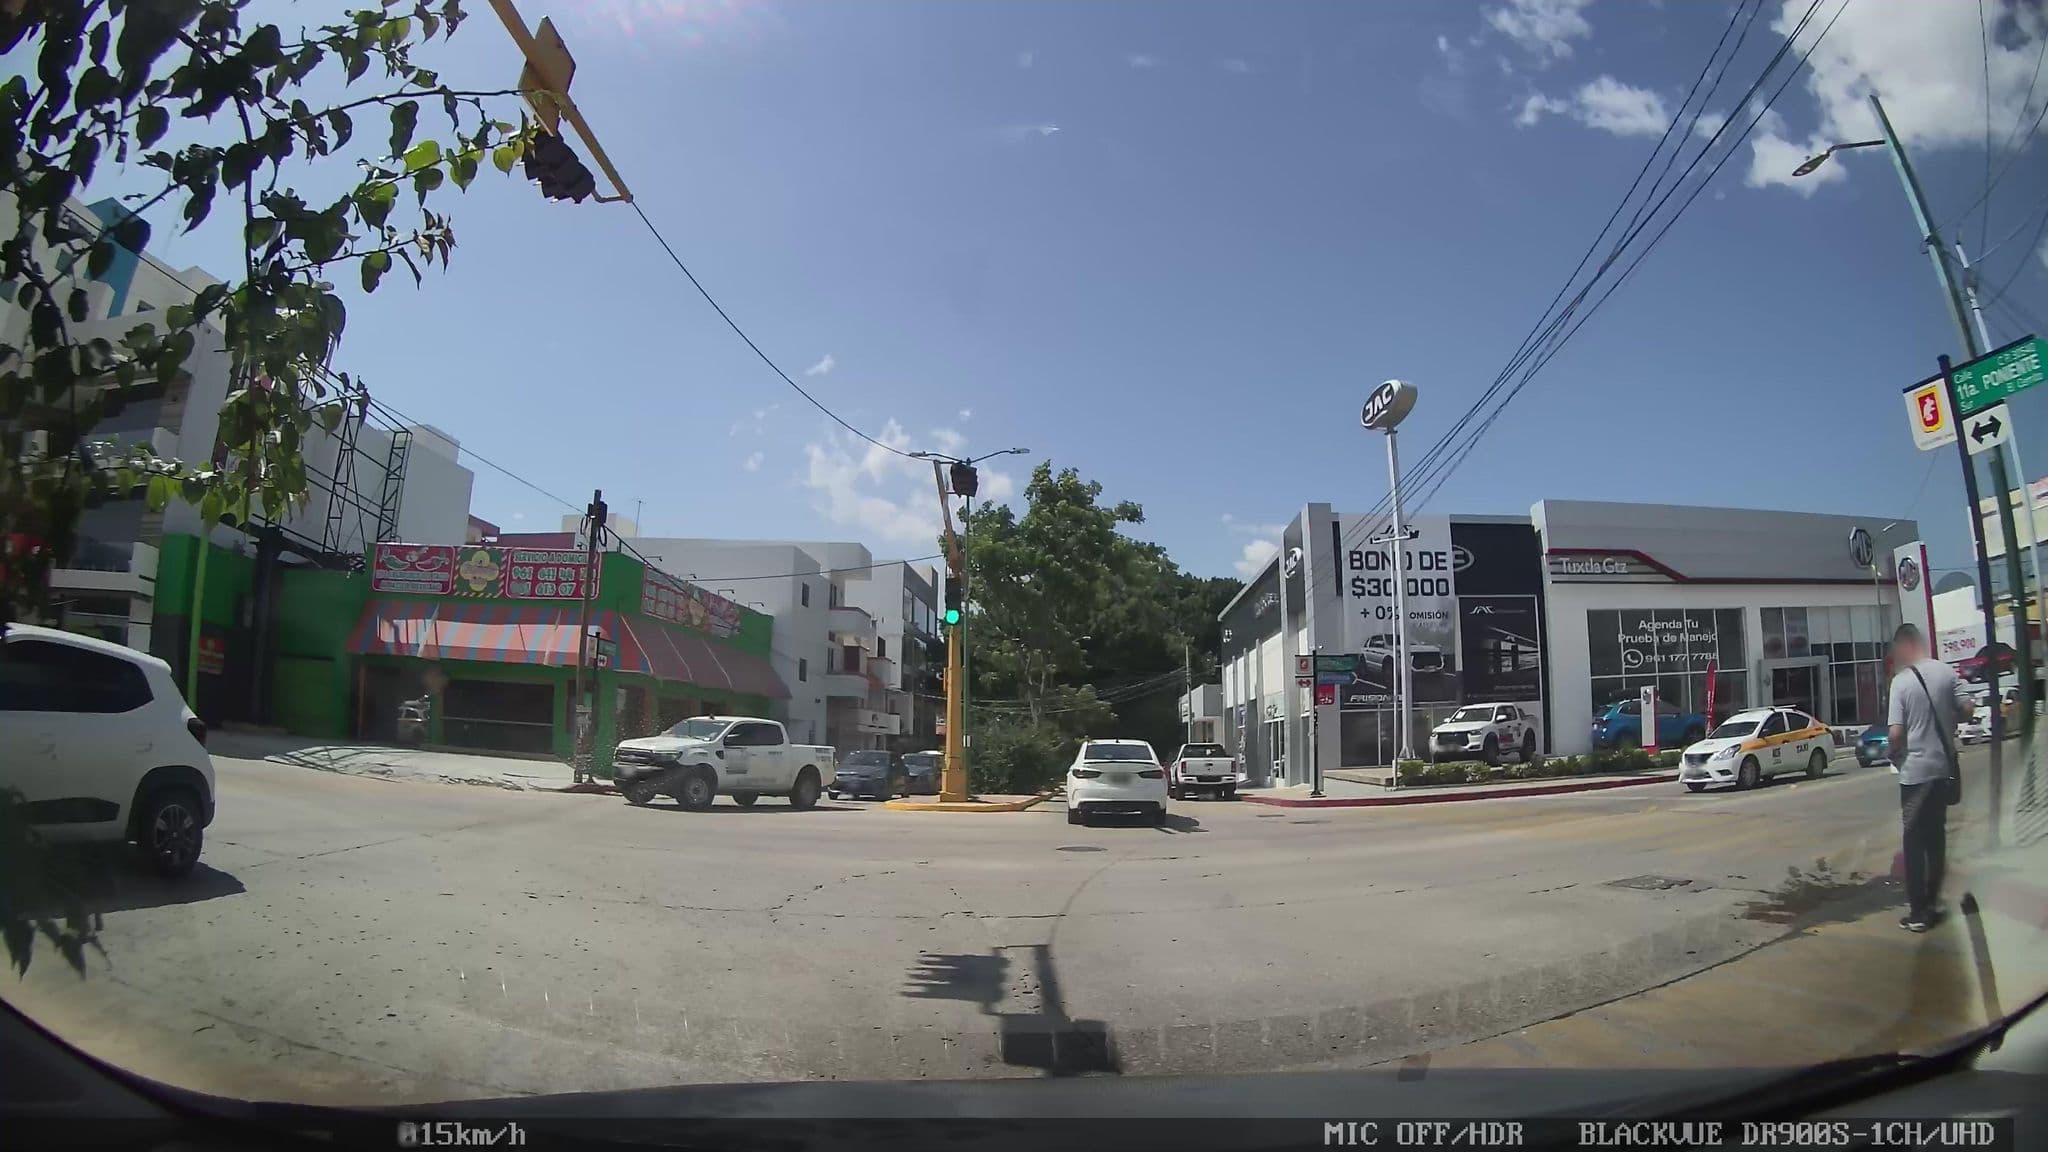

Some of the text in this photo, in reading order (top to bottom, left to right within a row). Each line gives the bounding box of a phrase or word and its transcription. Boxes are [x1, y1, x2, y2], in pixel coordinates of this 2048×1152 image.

[1953, 370, 1974, 384] Calle
[1365, 384, 1392, 421] JAC
[1419, 551, 1448, 571] DE
[1559, 557, 1629, 574] Tuxtla Gtz
[1409, 608, 1449, 620] OMISIÓN
[1638, 618, 1699, 632] Agenda Tu
[1662, 632, 1677, 643] de
